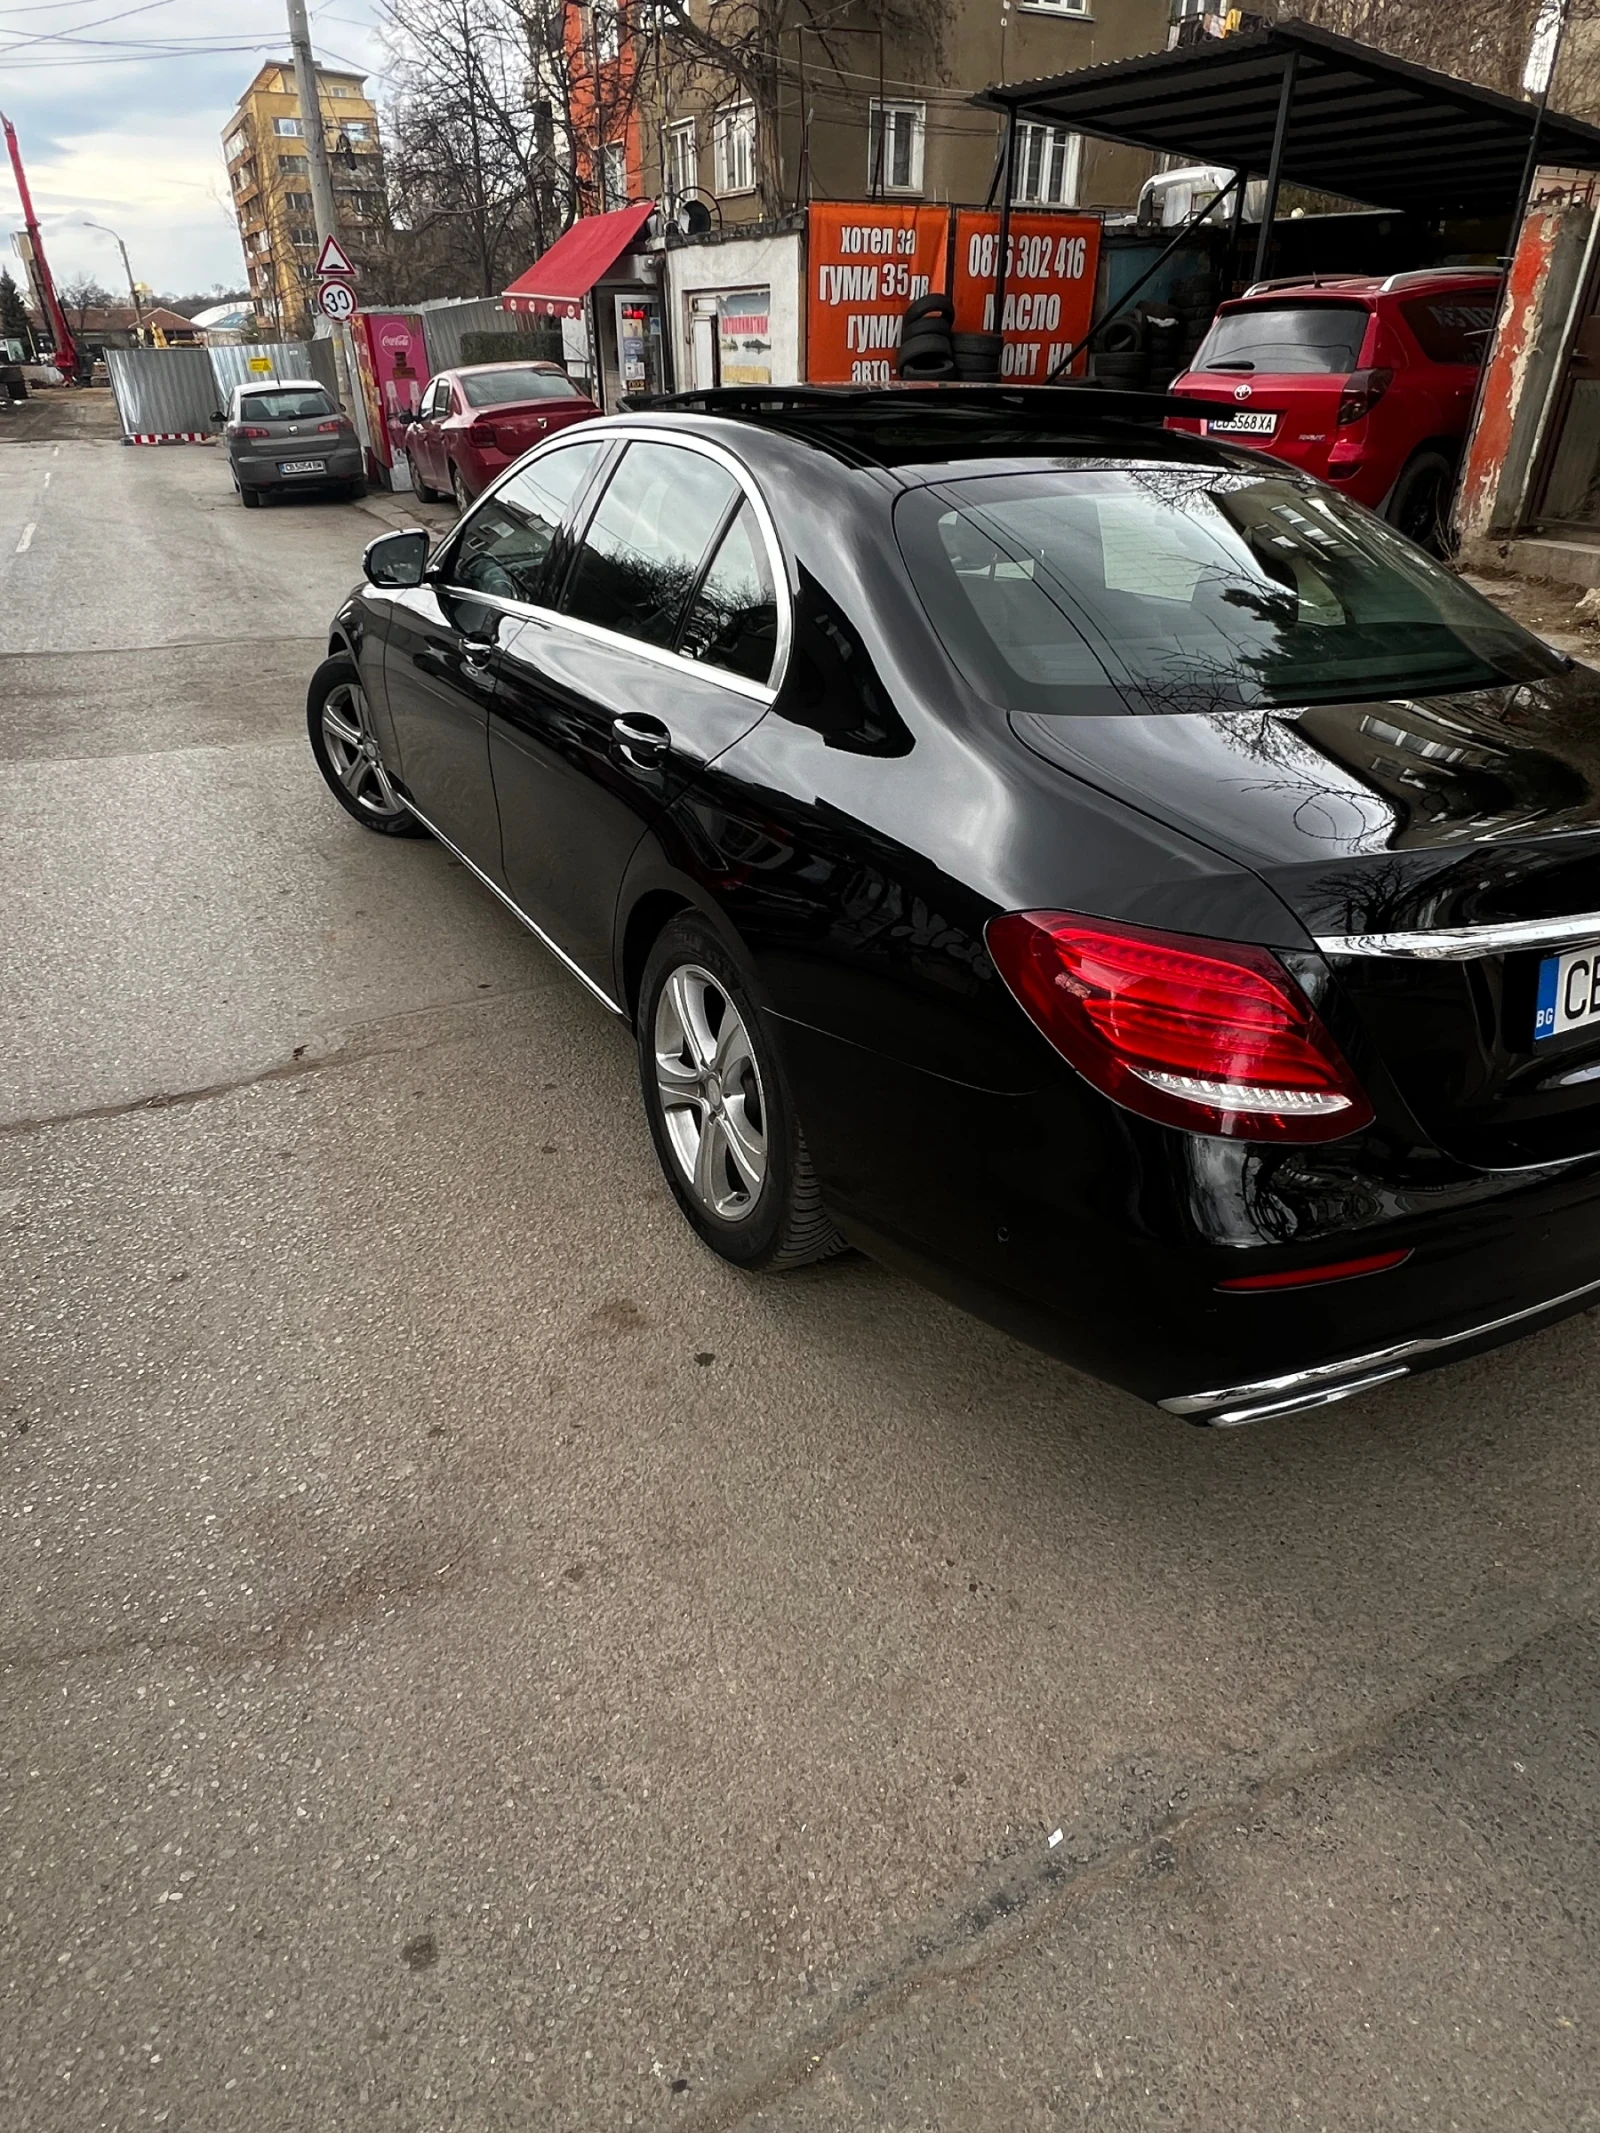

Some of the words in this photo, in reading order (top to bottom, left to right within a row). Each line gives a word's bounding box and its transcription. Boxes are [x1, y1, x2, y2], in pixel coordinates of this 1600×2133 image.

[841, 226, 893, 255] хотел
[896, 229, 916, 255] за
[1016, 234, 1053, 279] 302
[1053, 236, 1086, 279] 416
[881, 262, 909, 296] 35
[325, 289, 350, 312] 30
[1257, 416, 1273, 431] XA
[1536, 1007, 1554, 1028] BG
